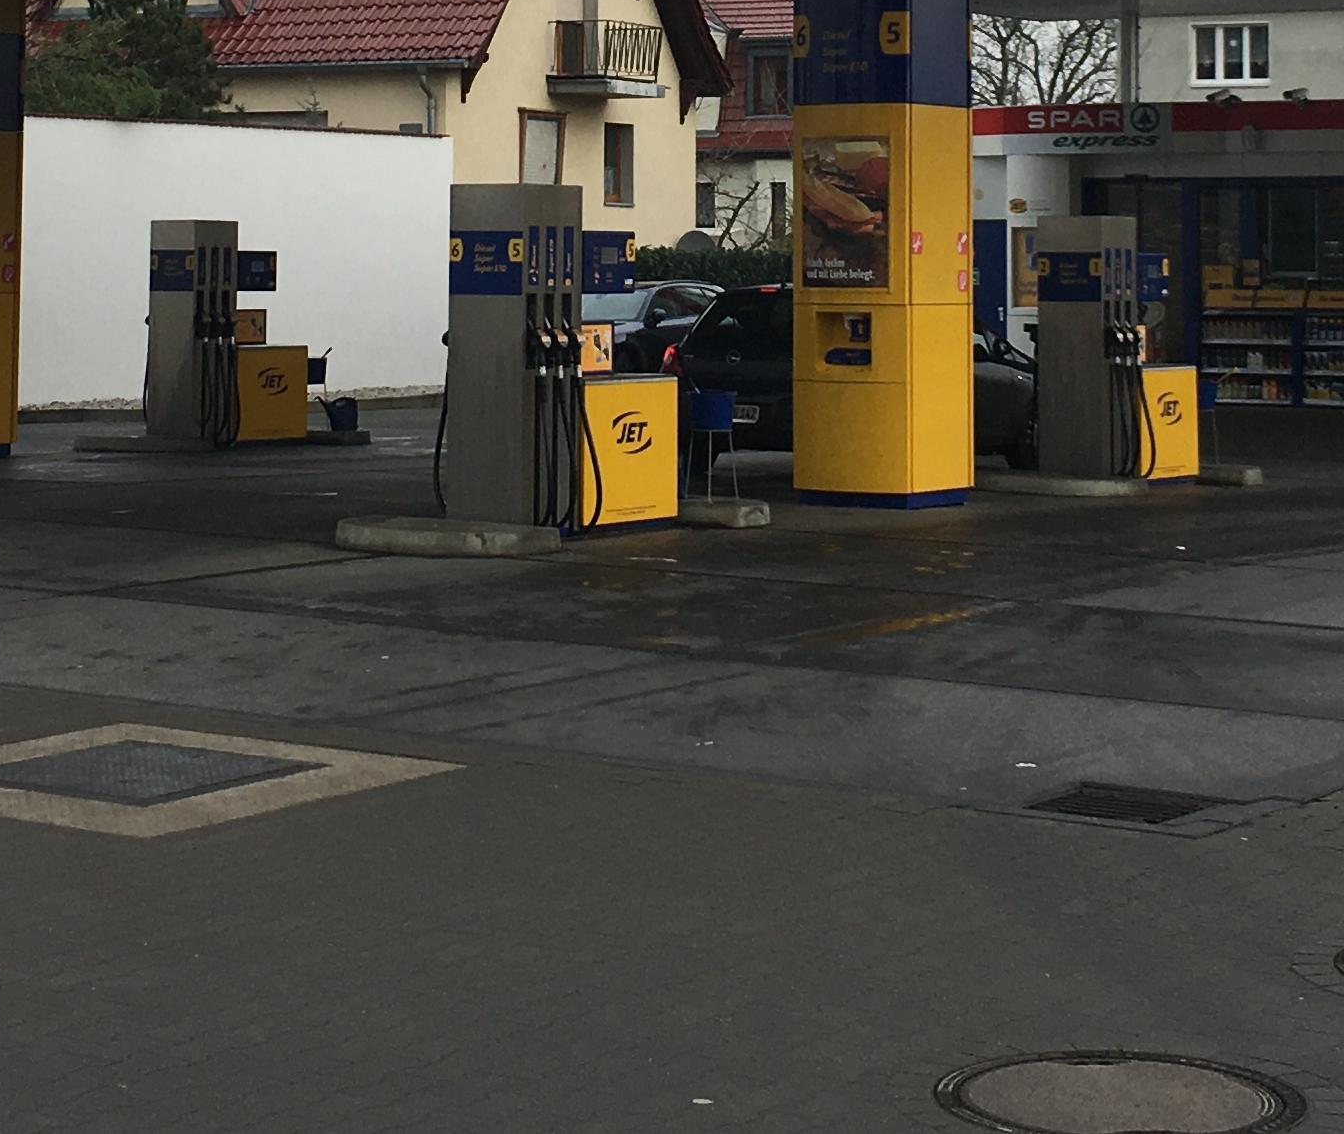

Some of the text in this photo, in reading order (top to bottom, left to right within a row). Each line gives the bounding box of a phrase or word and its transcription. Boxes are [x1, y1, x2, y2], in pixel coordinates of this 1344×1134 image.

[796, 22, 901, 46] 6 5
[1028, 110, 1120, 130] SPAR
[1052, 132, 1160, 151] express
[451, 242, 521, 258] 6 5
[261, 374, 286, 389] JET
[1161, 399, 1180, 417] JET
[616, 421, 649, 444] JET
